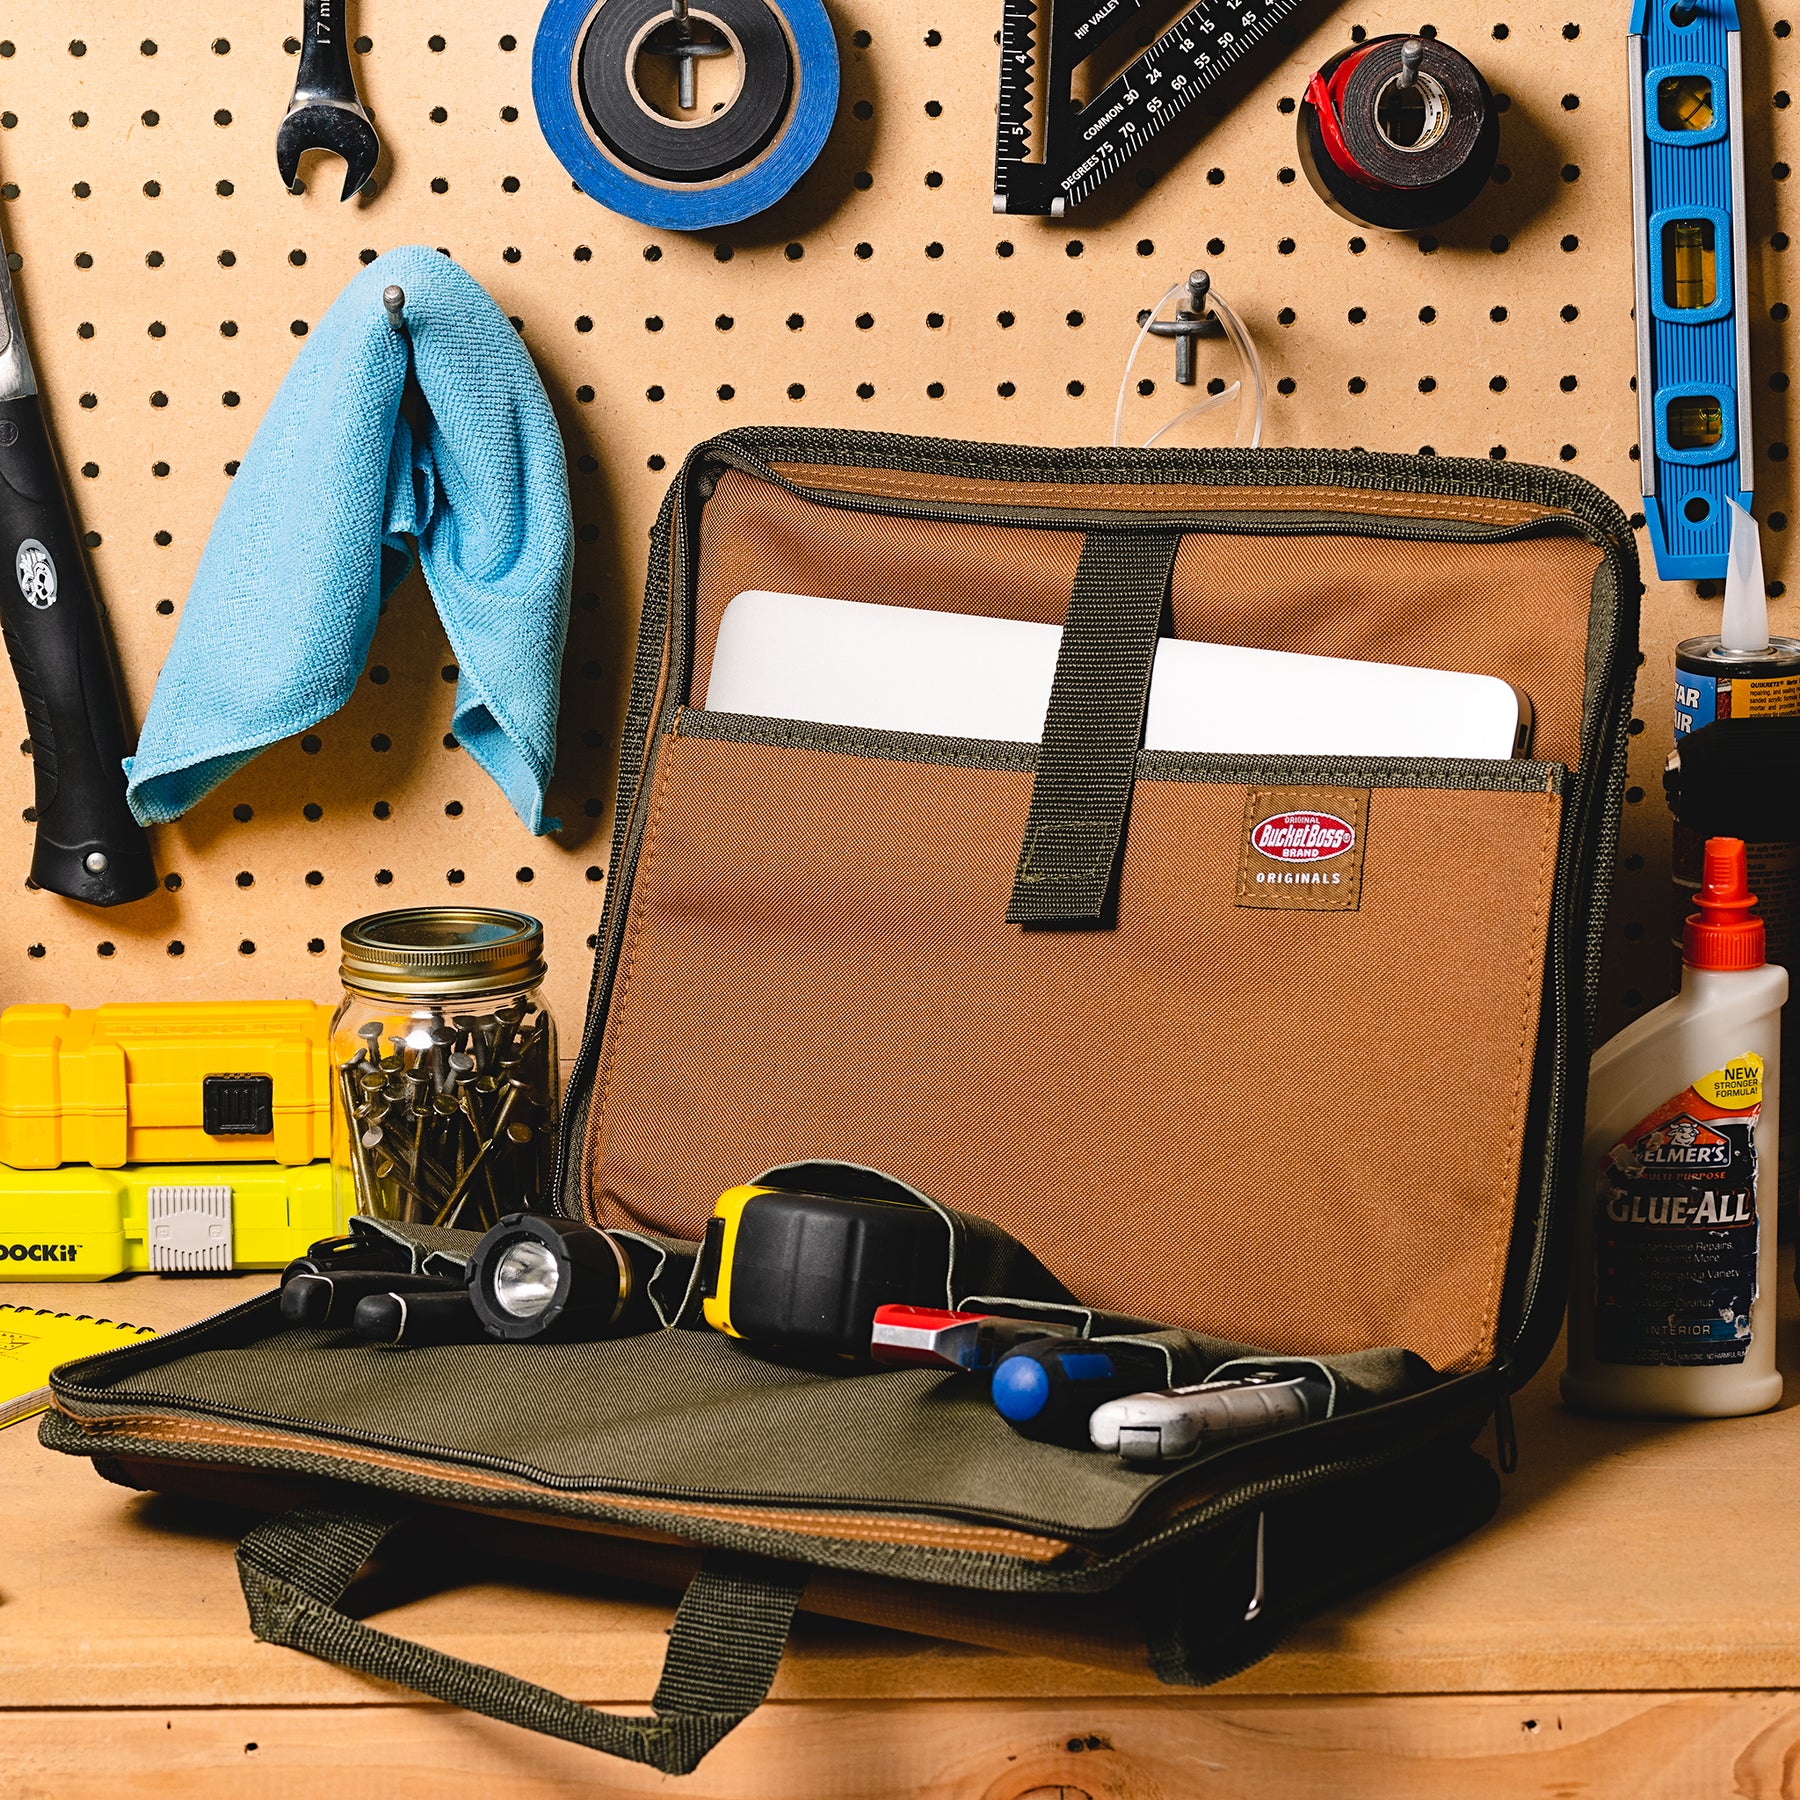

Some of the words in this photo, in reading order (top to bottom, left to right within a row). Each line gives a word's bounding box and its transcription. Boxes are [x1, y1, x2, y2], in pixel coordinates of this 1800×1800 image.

[1074, 24, 1090, 40] HIP
[1088, 0, 1120, 26] VALLEY
[1015, 54, 1027, 64] 4
[1083, 102, 1125, 141] COMMON
[1123, 89, 1140, 106] 30
[1145, 68, 1163, 85] 24
[1178, 38, 1195, 54] 18
[1199, 18, 1216, 35] 15
[1060, 154, 1100, 191] DEGREES
[1096, 141, 1114, 158] 75
[1118, 121, 1136, 138] 70
[1146, 96, 1163, 113] 65
[1170, 74, 1188, 91] 60
[1193, 52, 1211, 70] 55
[1217, 31, 1234, 49] 50
[1241, 10, 1257, 27] 45
[1012, 127, 1024, 135] 5
[1284, 816, 1321, 825] ORIGINAL
[1282, 848, 1320, 858] BRAND
[1256, 872, 1341, 884] ORIGINALS
[1724, 1067, 1759, 1081] NEW
[1714, 1079, 1758, 1090] STRONGER
[1715, 1087, 1758, 1098] FORMULA!
[1606, 1189, 1751, 1225] GLUE-ALL
[1647, 1324, 1712, 1336] INTERIOR
